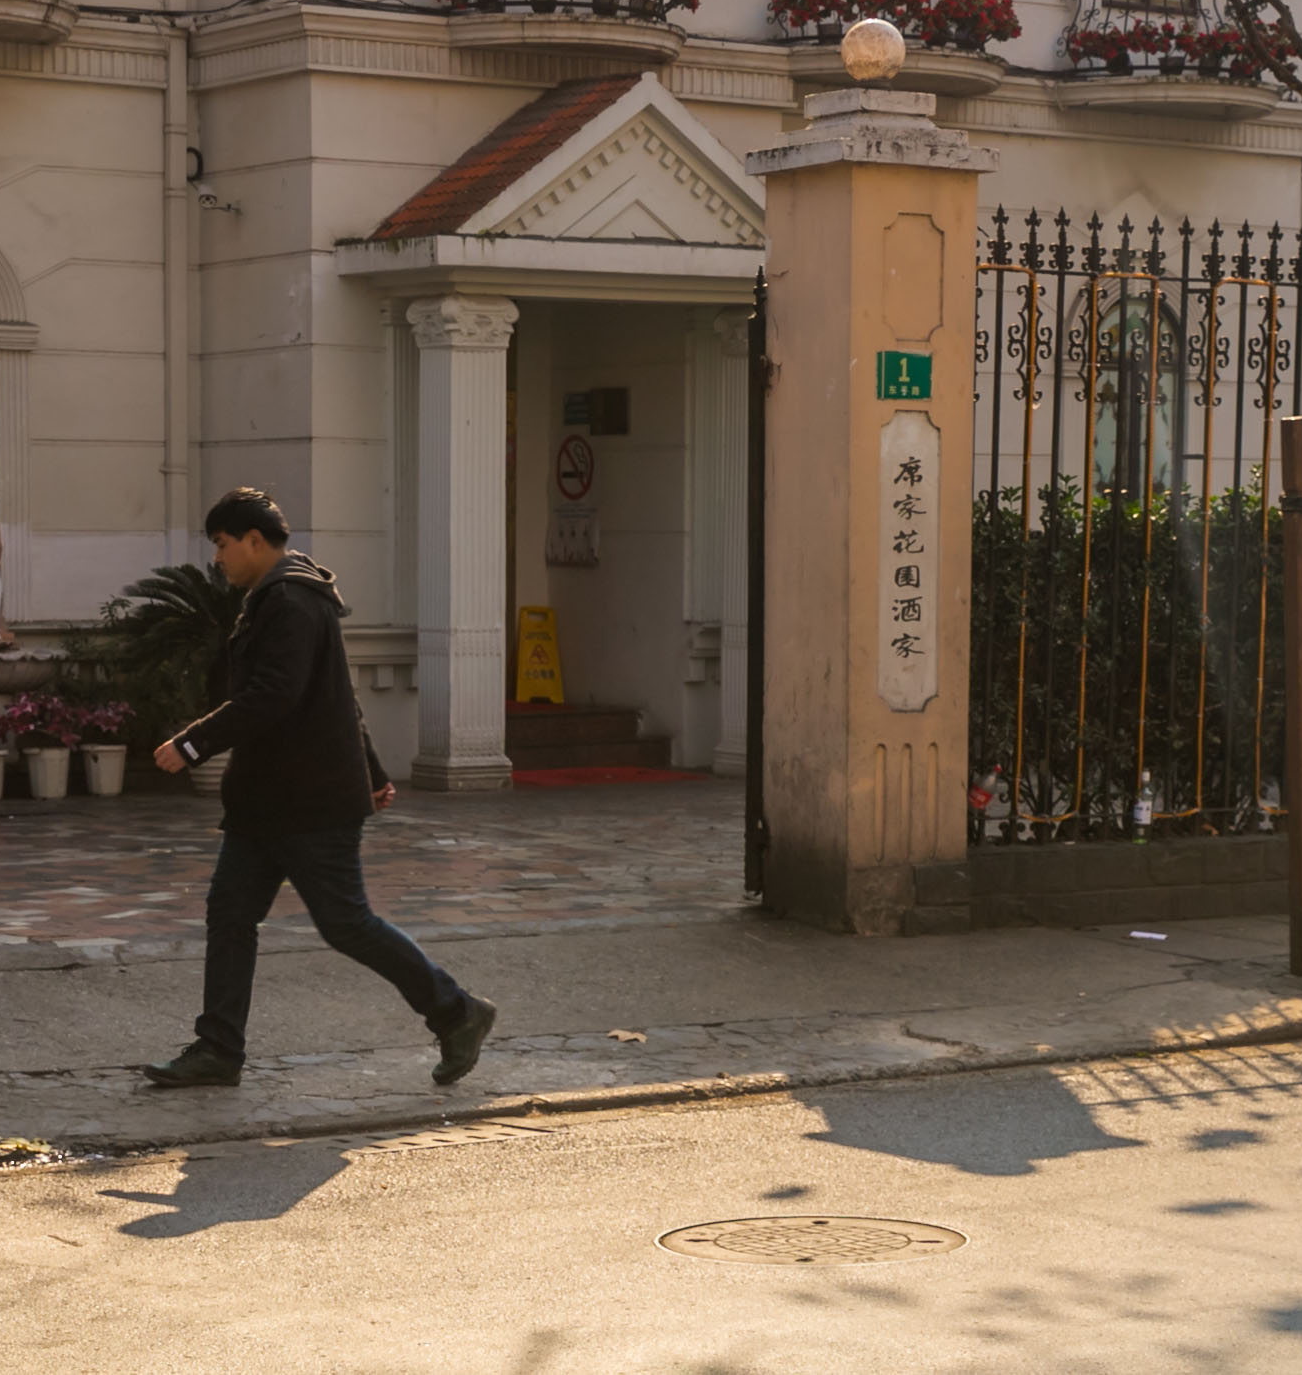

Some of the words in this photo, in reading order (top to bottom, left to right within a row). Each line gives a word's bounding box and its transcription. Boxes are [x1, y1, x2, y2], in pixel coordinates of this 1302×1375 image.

[898, 357, 910, 383] 1
[891, 456, 927, 660] 席家花園酒家
